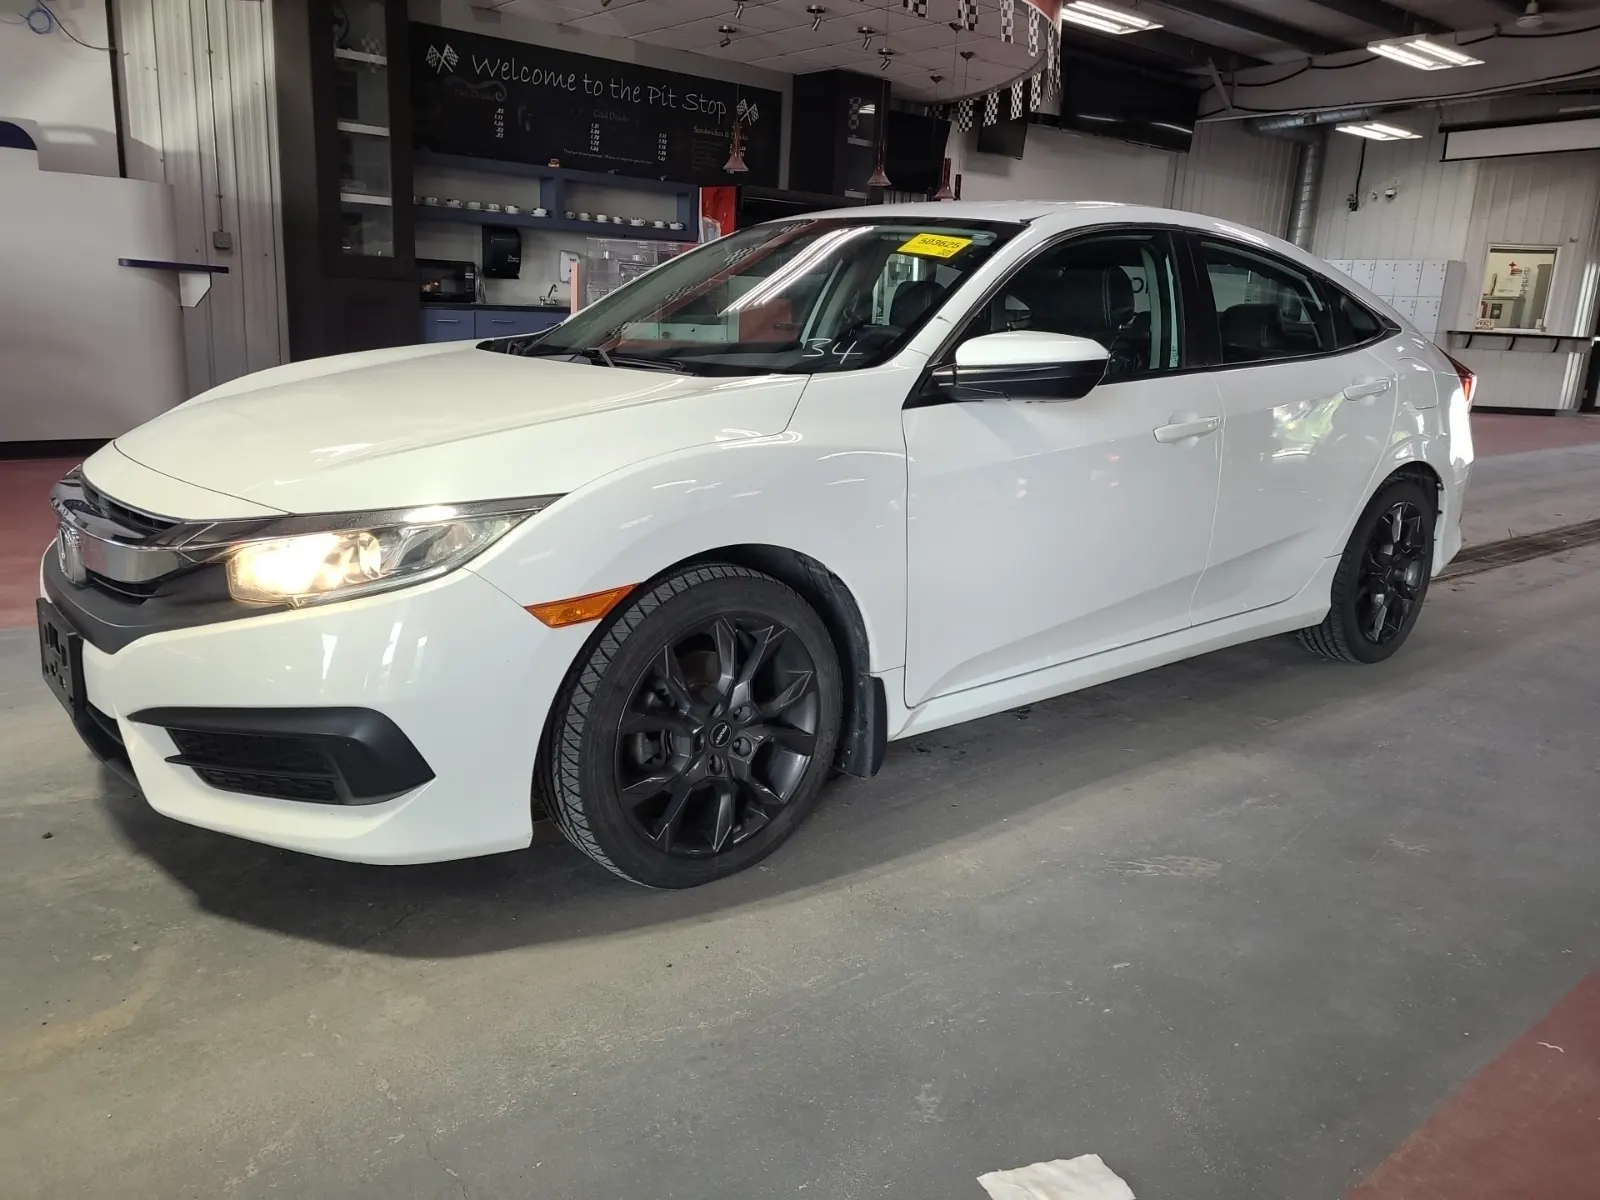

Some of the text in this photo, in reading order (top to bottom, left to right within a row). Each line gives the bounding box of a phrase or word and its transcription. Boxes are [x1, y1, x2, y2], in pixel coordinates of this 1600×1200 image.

[472, 53, 727, 124] Welcome to the Pit Stop
[801, 337, 863, 365] 34
